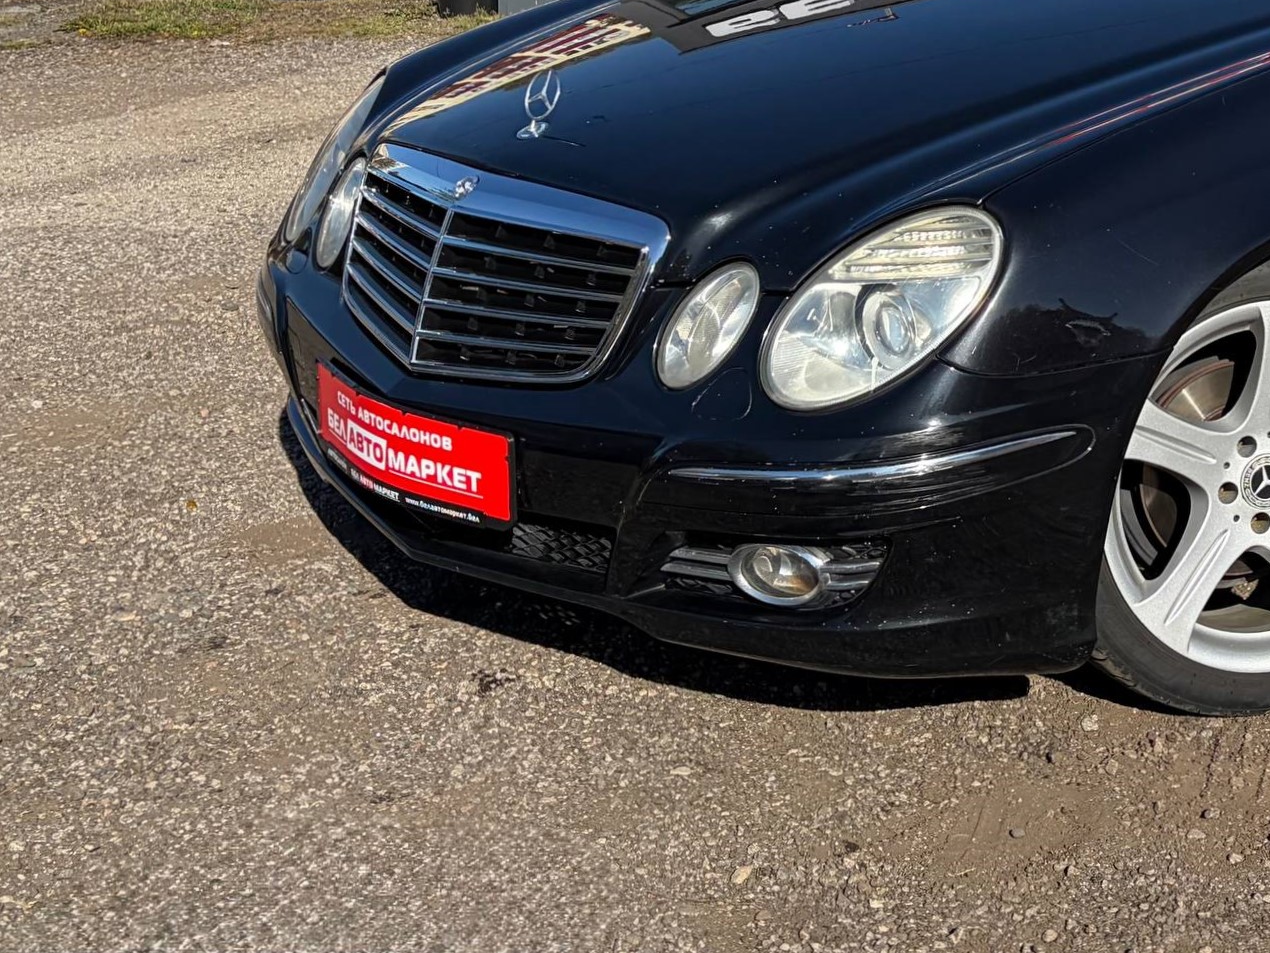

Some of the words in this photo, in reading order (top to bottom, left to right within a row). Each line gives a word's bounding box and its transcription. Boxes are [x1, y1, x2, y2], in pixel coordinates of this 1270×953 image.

[327, 407, 346, 442] БЕЛ
[349, 424, 384, 463] АВТО
[388, 448, 482, 493] МАРКЕТ
[337, 390, 356, 415] СЕТЬ
[357, 407, 453, 451] АВТОСАЛОНОВ
